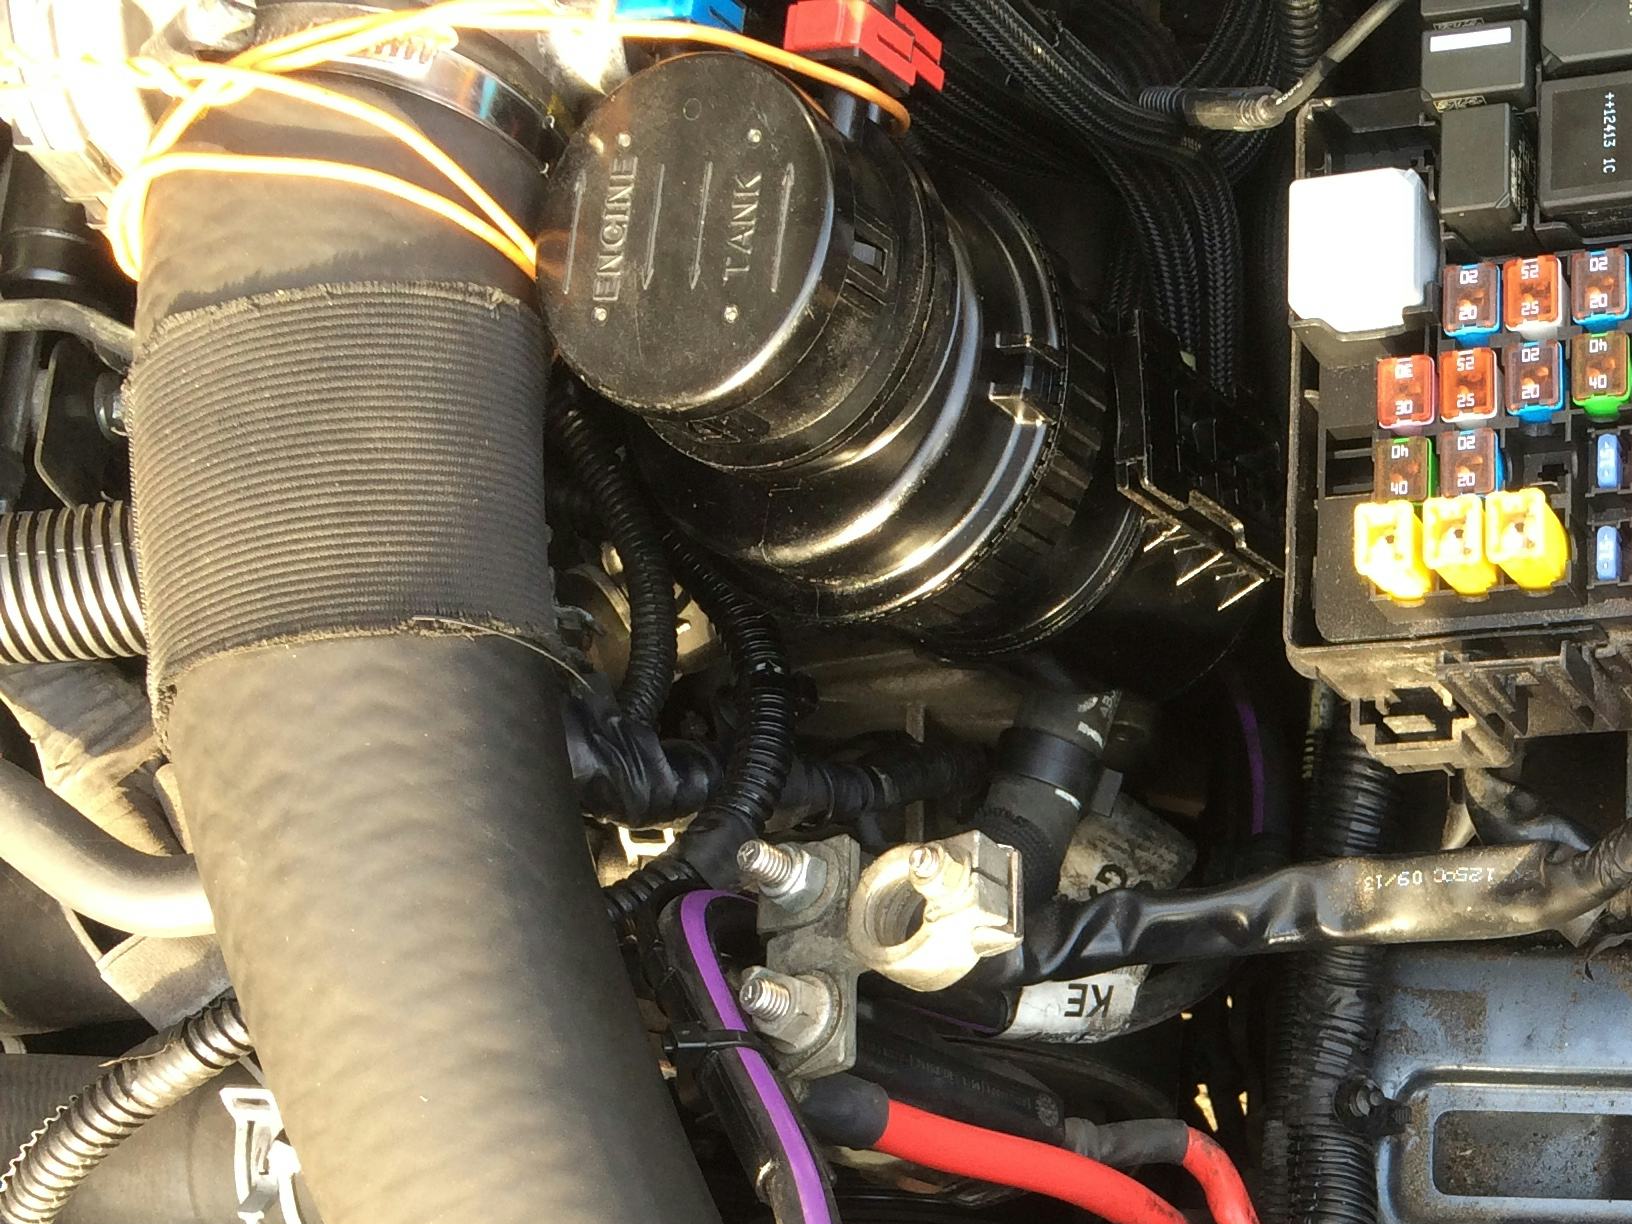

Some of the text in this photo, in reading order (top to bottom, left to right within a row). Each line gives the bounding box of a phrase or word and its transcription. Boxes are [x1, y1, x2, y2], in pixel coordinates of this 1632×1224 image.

[593, 155, 639, 302] ENGINE
[722, 172, 762, 283] TANK
[1521, 265, 1539, 279] 25
[1589, 257, 1608, 272] 20
[1459, 269, 1478, 285] 20
[1521, 300, 1539, 315] 25
[1589, 294, 1608, 309] 20
[1458, 306, 1478, 321] 20
[1588, 339, 1607, 353] 40
[1521, 347, 1540, 362] 20
[1394, 363, 1414, 379] 30
[1456, 356, 1475, 372] 25
[1588, 374, 1607, 390] 40
[1521, 384, 1540, 400] 20
[1394, 400, 1413, 415] 30
[1456, 393, 1475, 408] 25
[1457, 436, 1476, 451] 20
[1391, 445, 1409, 459] 40
[1457, 472, 1476, 487] 20
[1390, 480, 1408, 495] 40
[1362, 869, 1423, 891] 09/13
[1064, 982, 1113, 1018] KE
